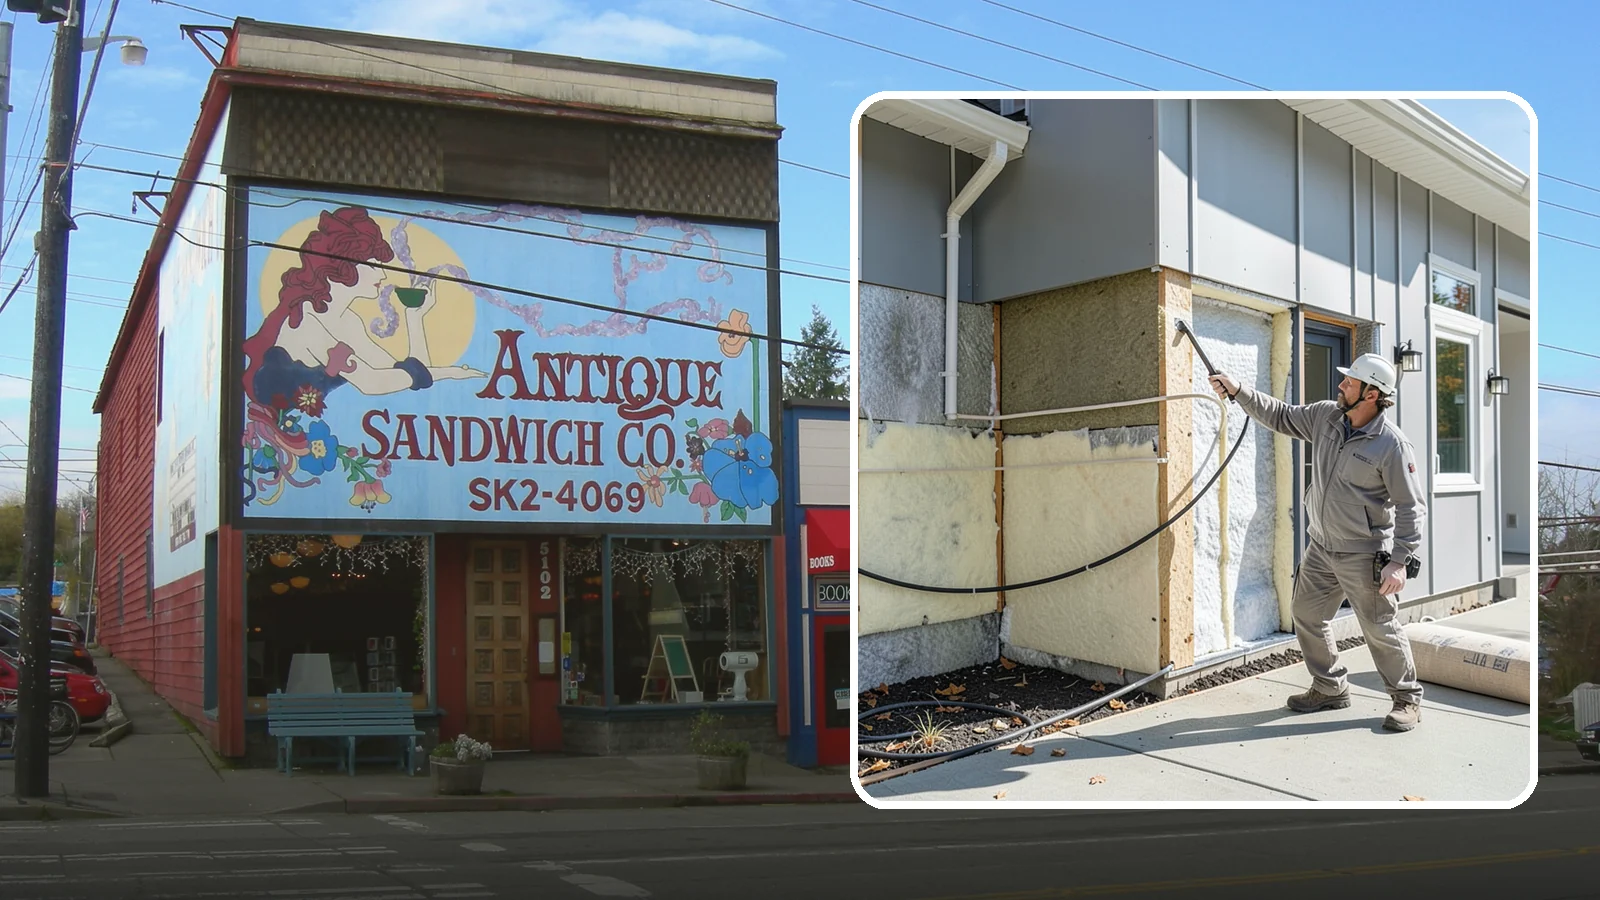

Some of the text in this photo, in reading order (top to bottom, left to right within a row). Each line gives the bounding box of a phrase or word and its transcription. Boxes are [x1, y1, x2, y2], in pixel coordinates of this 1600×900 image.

[475, 329, 724, 421] ANTIQUE
[361, 408, 685, 469] SANDWICH CO.
[468, 477, 646, 513] SK2-4069
[540, 541, 551, 599] 5102
[809, 555, 835, 569] BOOKS
